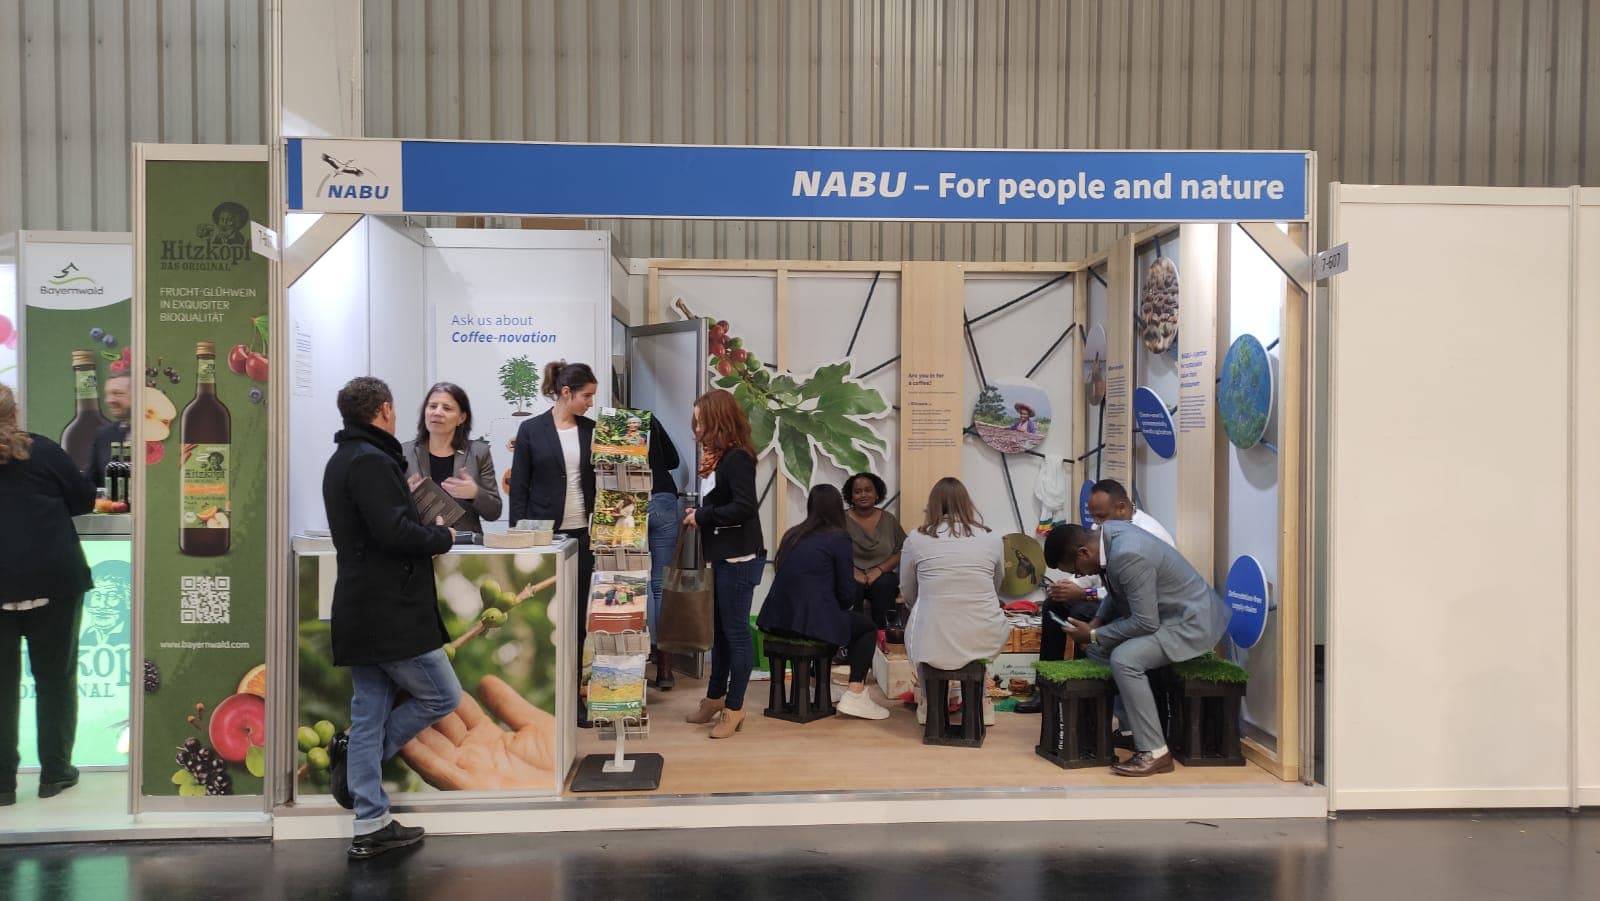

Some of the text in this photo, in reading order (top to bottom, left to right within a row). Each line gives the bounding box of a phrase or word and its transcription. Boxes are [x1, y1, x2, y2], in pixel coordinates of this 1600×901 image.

[328, 185, 389, 199] NABU
[792, 171, 907, 198] NABU
[939, 172, 991, 198] For
[998, 172, 1106, 205] people
[1113, 172, 1172, 199] and
[1181, 174, 1285, 199] nature
[160, 262, 231, 272] DAS ORIGINAL
[40, 285, 104, 296] Bayernwald
[160, 300, 230, 310] IN EXQUISITER
[160, 311, 225, 322] BIOQUALITÄT
[451, 314, 534, 326] Ask us about
[451, 331, 557, 343] Coffee-novation
[159, 640, 250, 650] www.bayernwald.com
